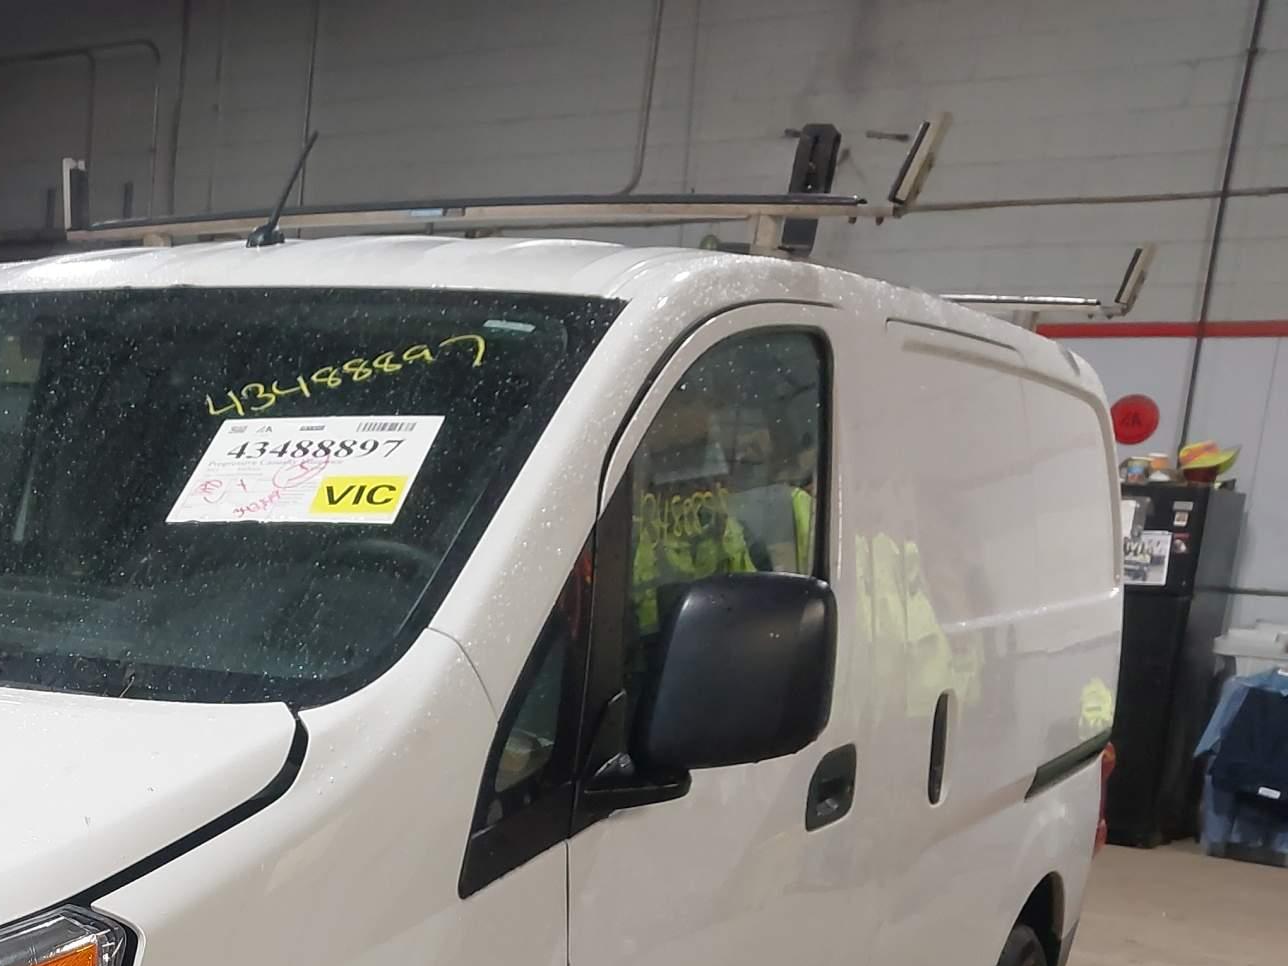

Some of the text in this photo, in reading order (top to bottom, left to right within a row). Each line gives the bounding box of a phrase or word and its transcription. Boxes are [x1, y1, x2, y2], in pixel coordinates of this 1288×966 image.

[206, 334, 486, 416] 43488897
[226, 439, 406, 459] 43488897
[326, 484, 397, 506] VIC
